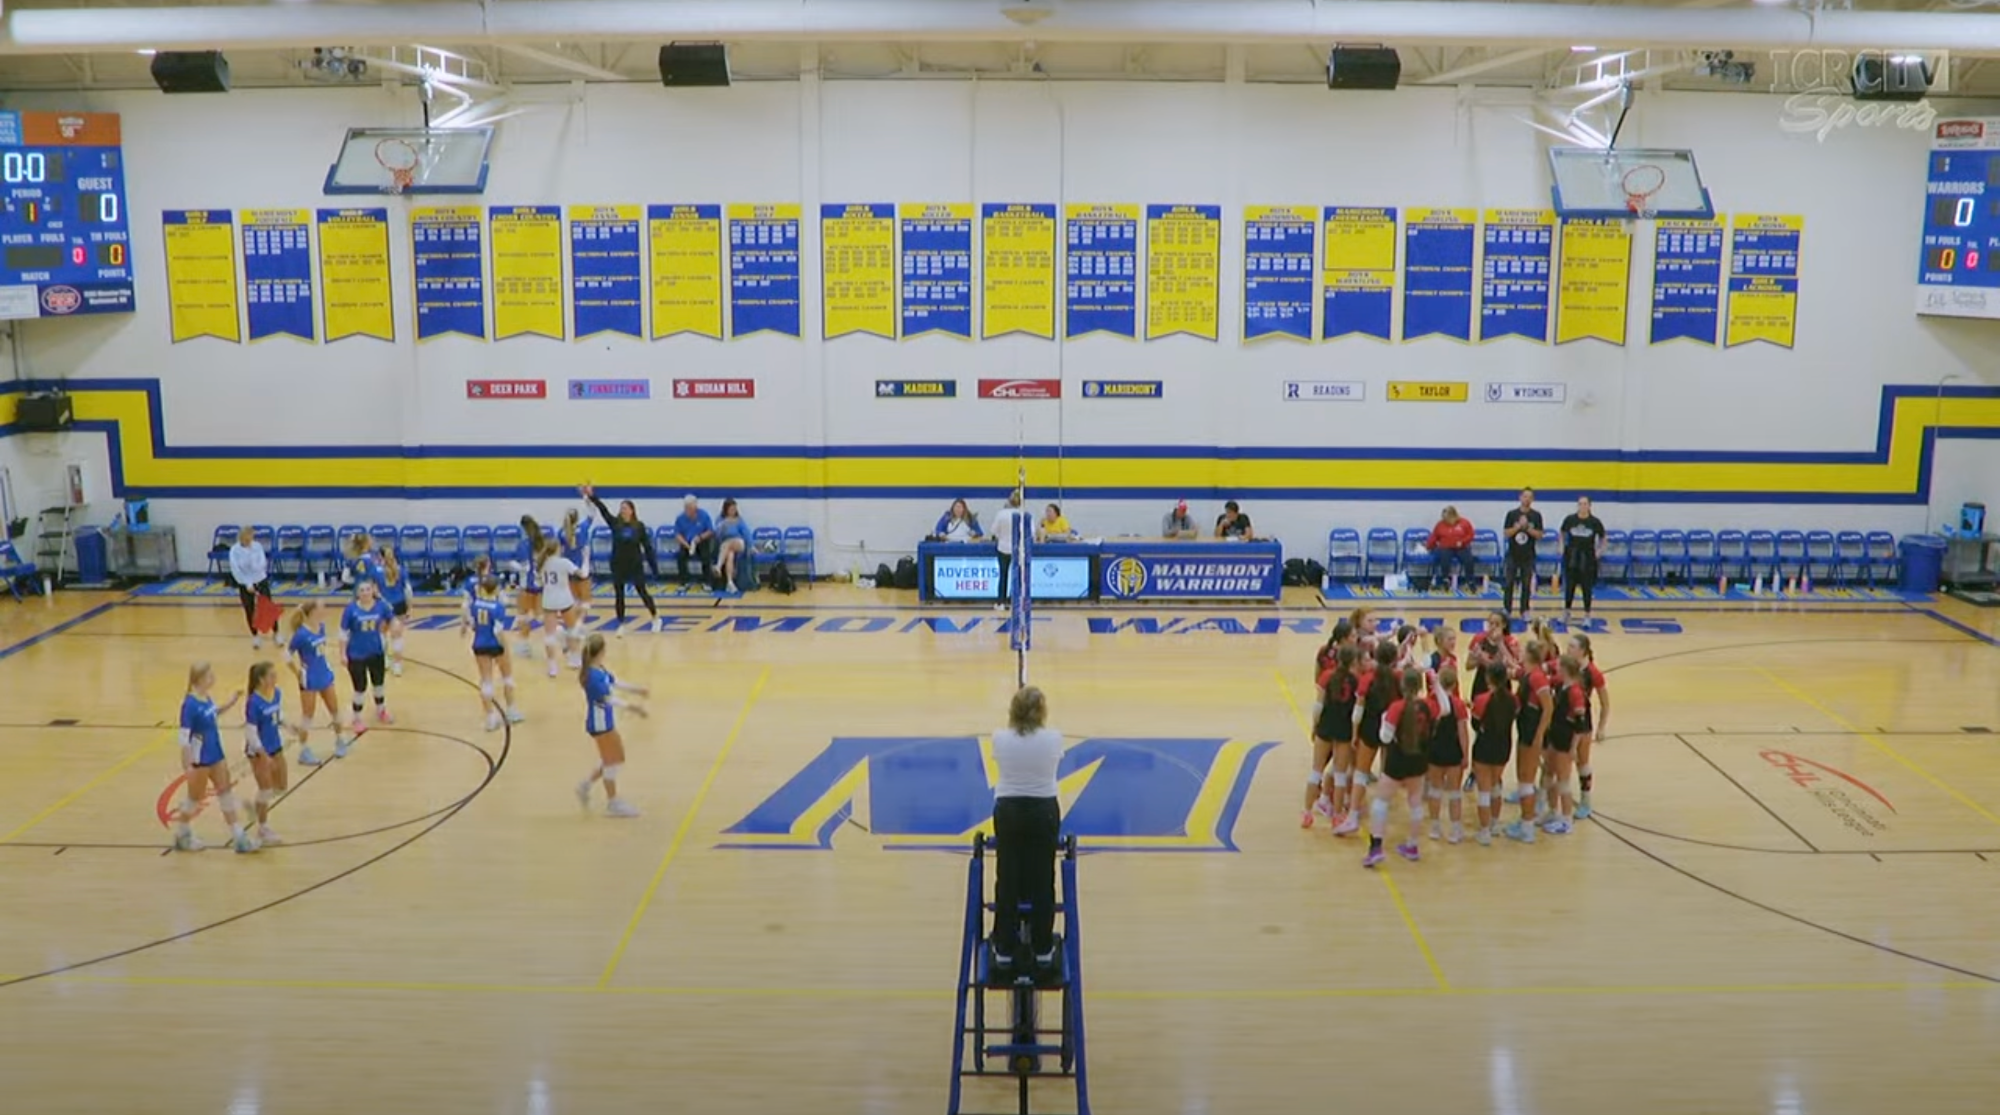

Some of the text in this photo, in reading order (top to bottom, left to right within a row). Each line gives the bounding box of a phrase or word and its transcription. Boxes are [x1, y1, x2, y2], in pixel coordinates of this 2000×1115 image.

[77, 177, 113, 190] GUEST
[1927, 181, 1986, 195] WARRIORS
[12, 188, 42, 198] PERIOD
[100, 193, 118, 222] 0
[1954, 198, 1975, 227] 0
[72, 246, 85, 264] 0
[110, 244, 123, 265] 0
[1941, 248, 1955, 270] 0
[1966, 251, 1979, 268] 0
[490, 383, 538, 395] DEER PARK
[695, 383, 748, 395] INDIAN HILL
[903, 383, 944, 394] MADEIRA
[993, 388, 1020, 397] CHL
[1103, 383, 1157, 395] MARIEMONT
[1313, 385, 1350, 396] READING
[1419, 386, 1450, 396] TAYLOR
[1513, 387, 1553, 398] WYOMING
[937, 567, 999, 577] ADVERTIS
[1151, 564, 1273, 576] MARIEMONT
[544, 571, 559, 584] 13
[956, 580, 989, 591] HERE
[1156, 578, 1262, 591] WARRIORS
